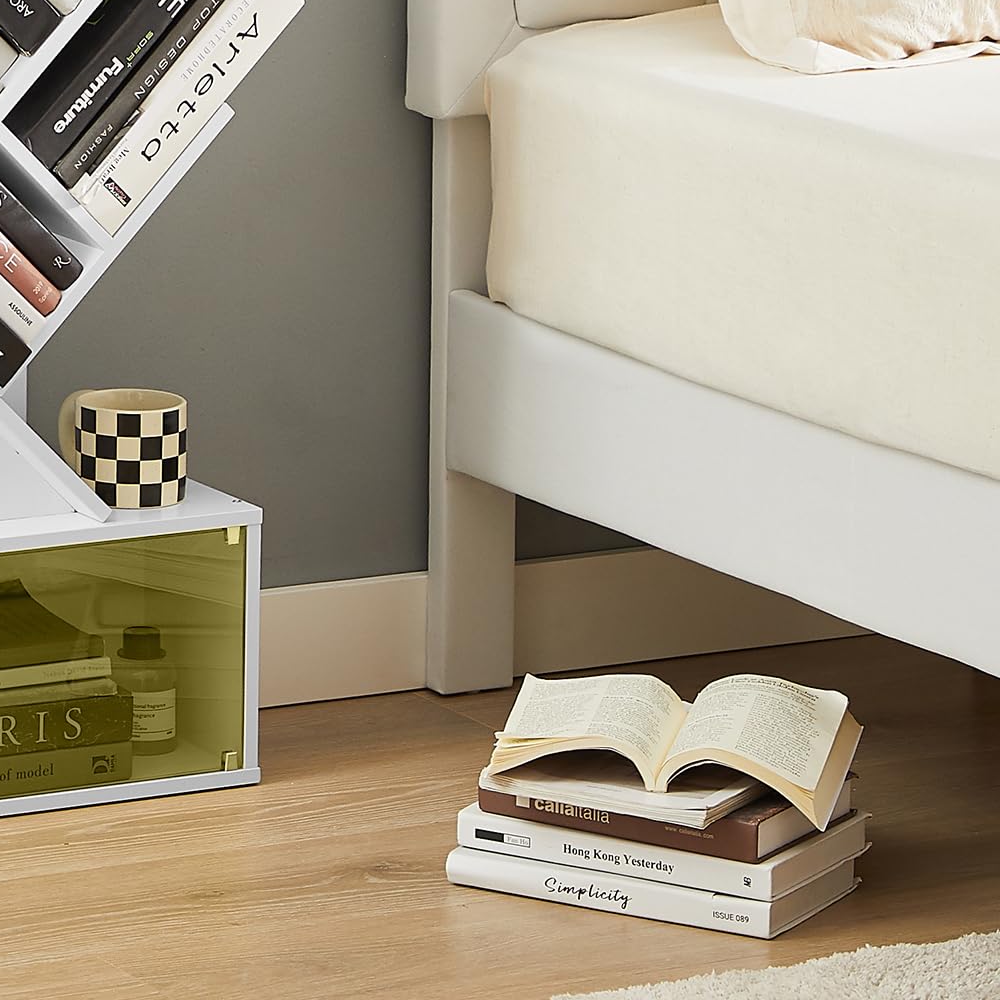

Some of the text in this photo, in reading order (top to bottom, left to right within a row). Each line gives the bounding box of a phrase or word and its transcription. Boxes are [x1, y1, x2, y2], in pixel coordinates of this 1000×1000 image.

[133, 35, 195, 100] DESIGN
[140, 12, 259, 162] Arletta
[53, 56, 126, 134] Furniture
[73, 123, 114, 170] FASHION
[15, 763, 56, 781] model
[562, 843, 675, 875] Hong Kong Yesterday
[544, 877, 633, 910] Simplicity
[712, 911, 750, 923] ISSUE 089
